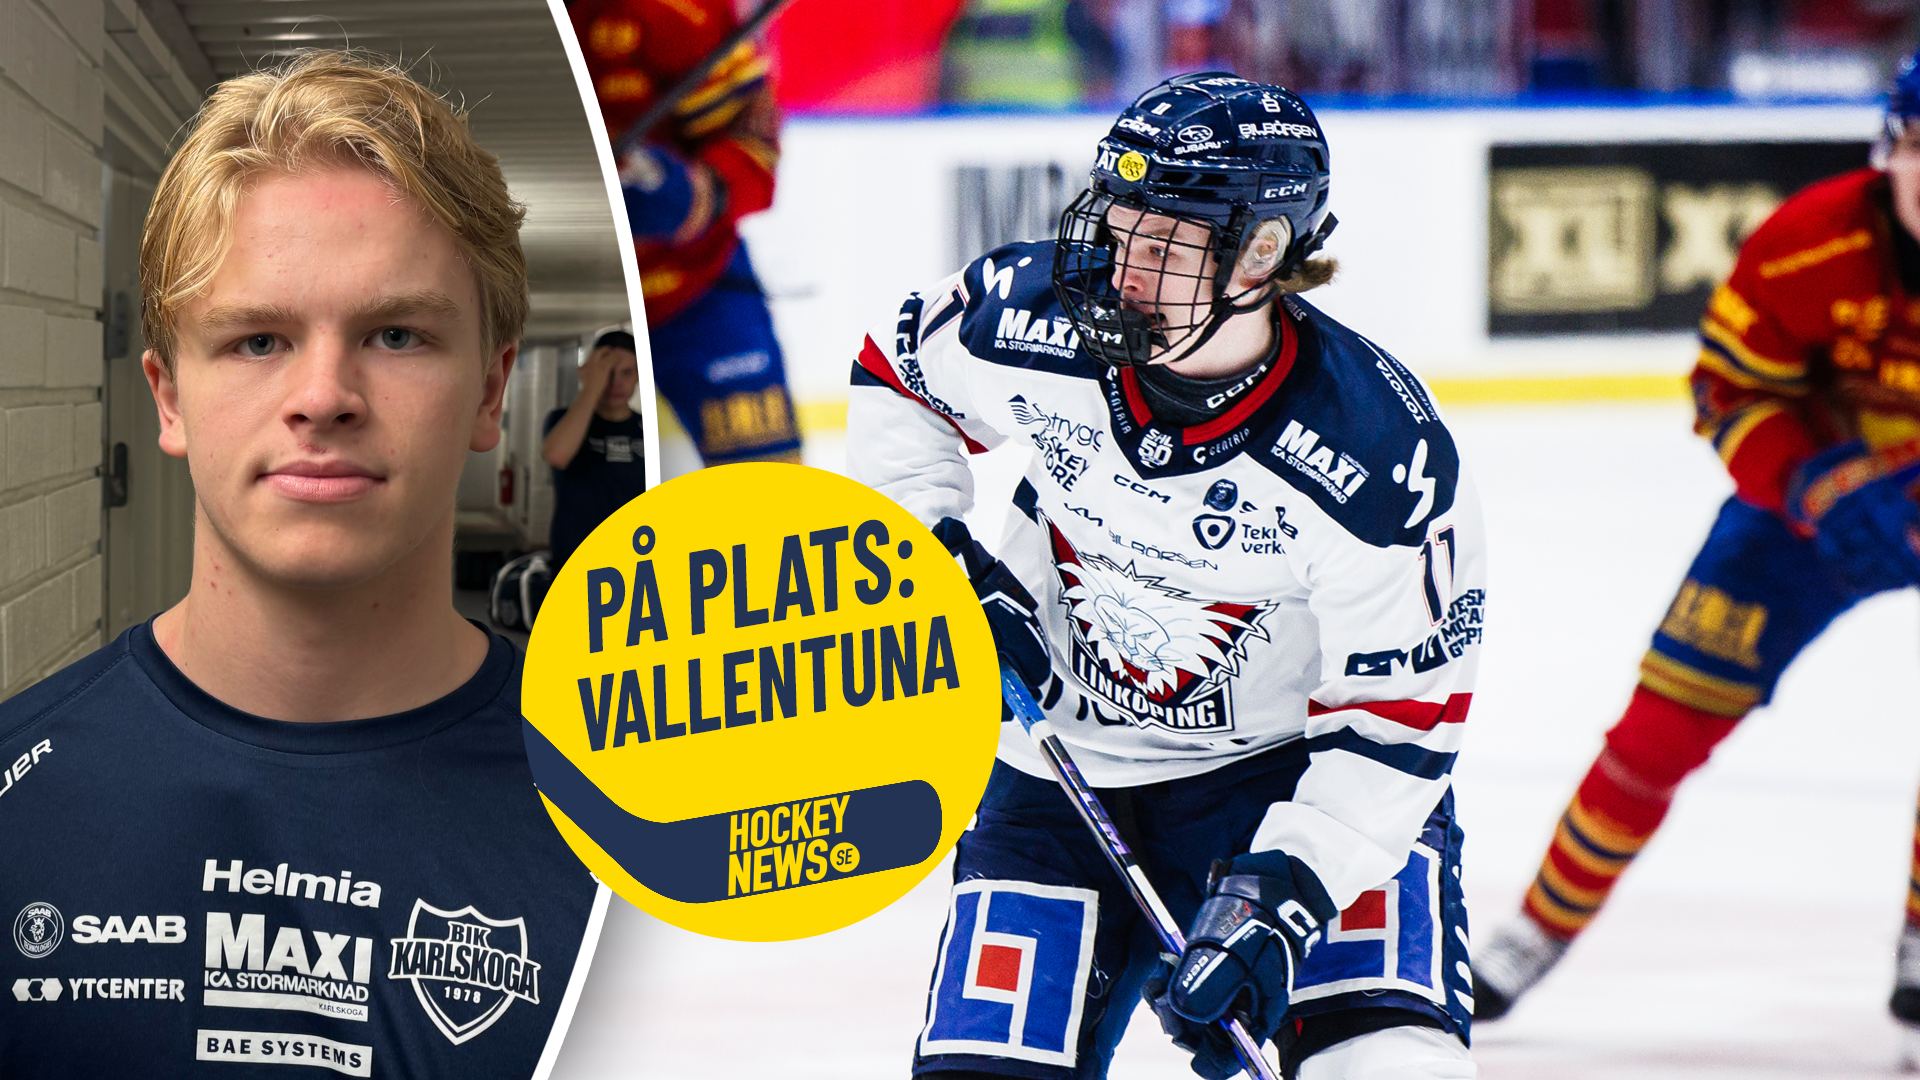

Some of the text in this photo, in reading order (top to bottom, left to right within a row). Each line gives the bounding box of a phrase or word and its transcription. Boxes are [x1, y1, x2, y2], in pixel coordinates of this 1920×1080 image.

[1173, 141, 1222, 155] SUBARU
[1264, 182, 1308, 199] CCM
[996, 308, 1081, 350] MAXI
[1206, 363, 1267, 409] CCM
[1375, 360, 1424, 425] TOYOTA
[1276, 419, 1367, 498] MAXI
[1113, 474, 1171, 503] CCM
[1286, 454, 1348, 504] STORMARKNAD
[1078, 650, 1217, 727] LINKÖPING
[202, 859, 382, 908] Helmia
[27, 908, 52, 918] SAAB
[71, 915, 187, 944] SAAB
[449, 922, 490, 948] BIK
[205, 911, 373, 984] MAXI
[391, 940, 538, 999] KARLSKOGA
[69, 978, 185, 1003] YTCENTER
[204, 970, 369, 1002] ICA STORMARKNAD
[444, 986, 481, 1004] 1978
[318, 1003, 364, 1016] KARLSKOGA
[207, 1037, 362, 1068] BAE SYSTEMS
